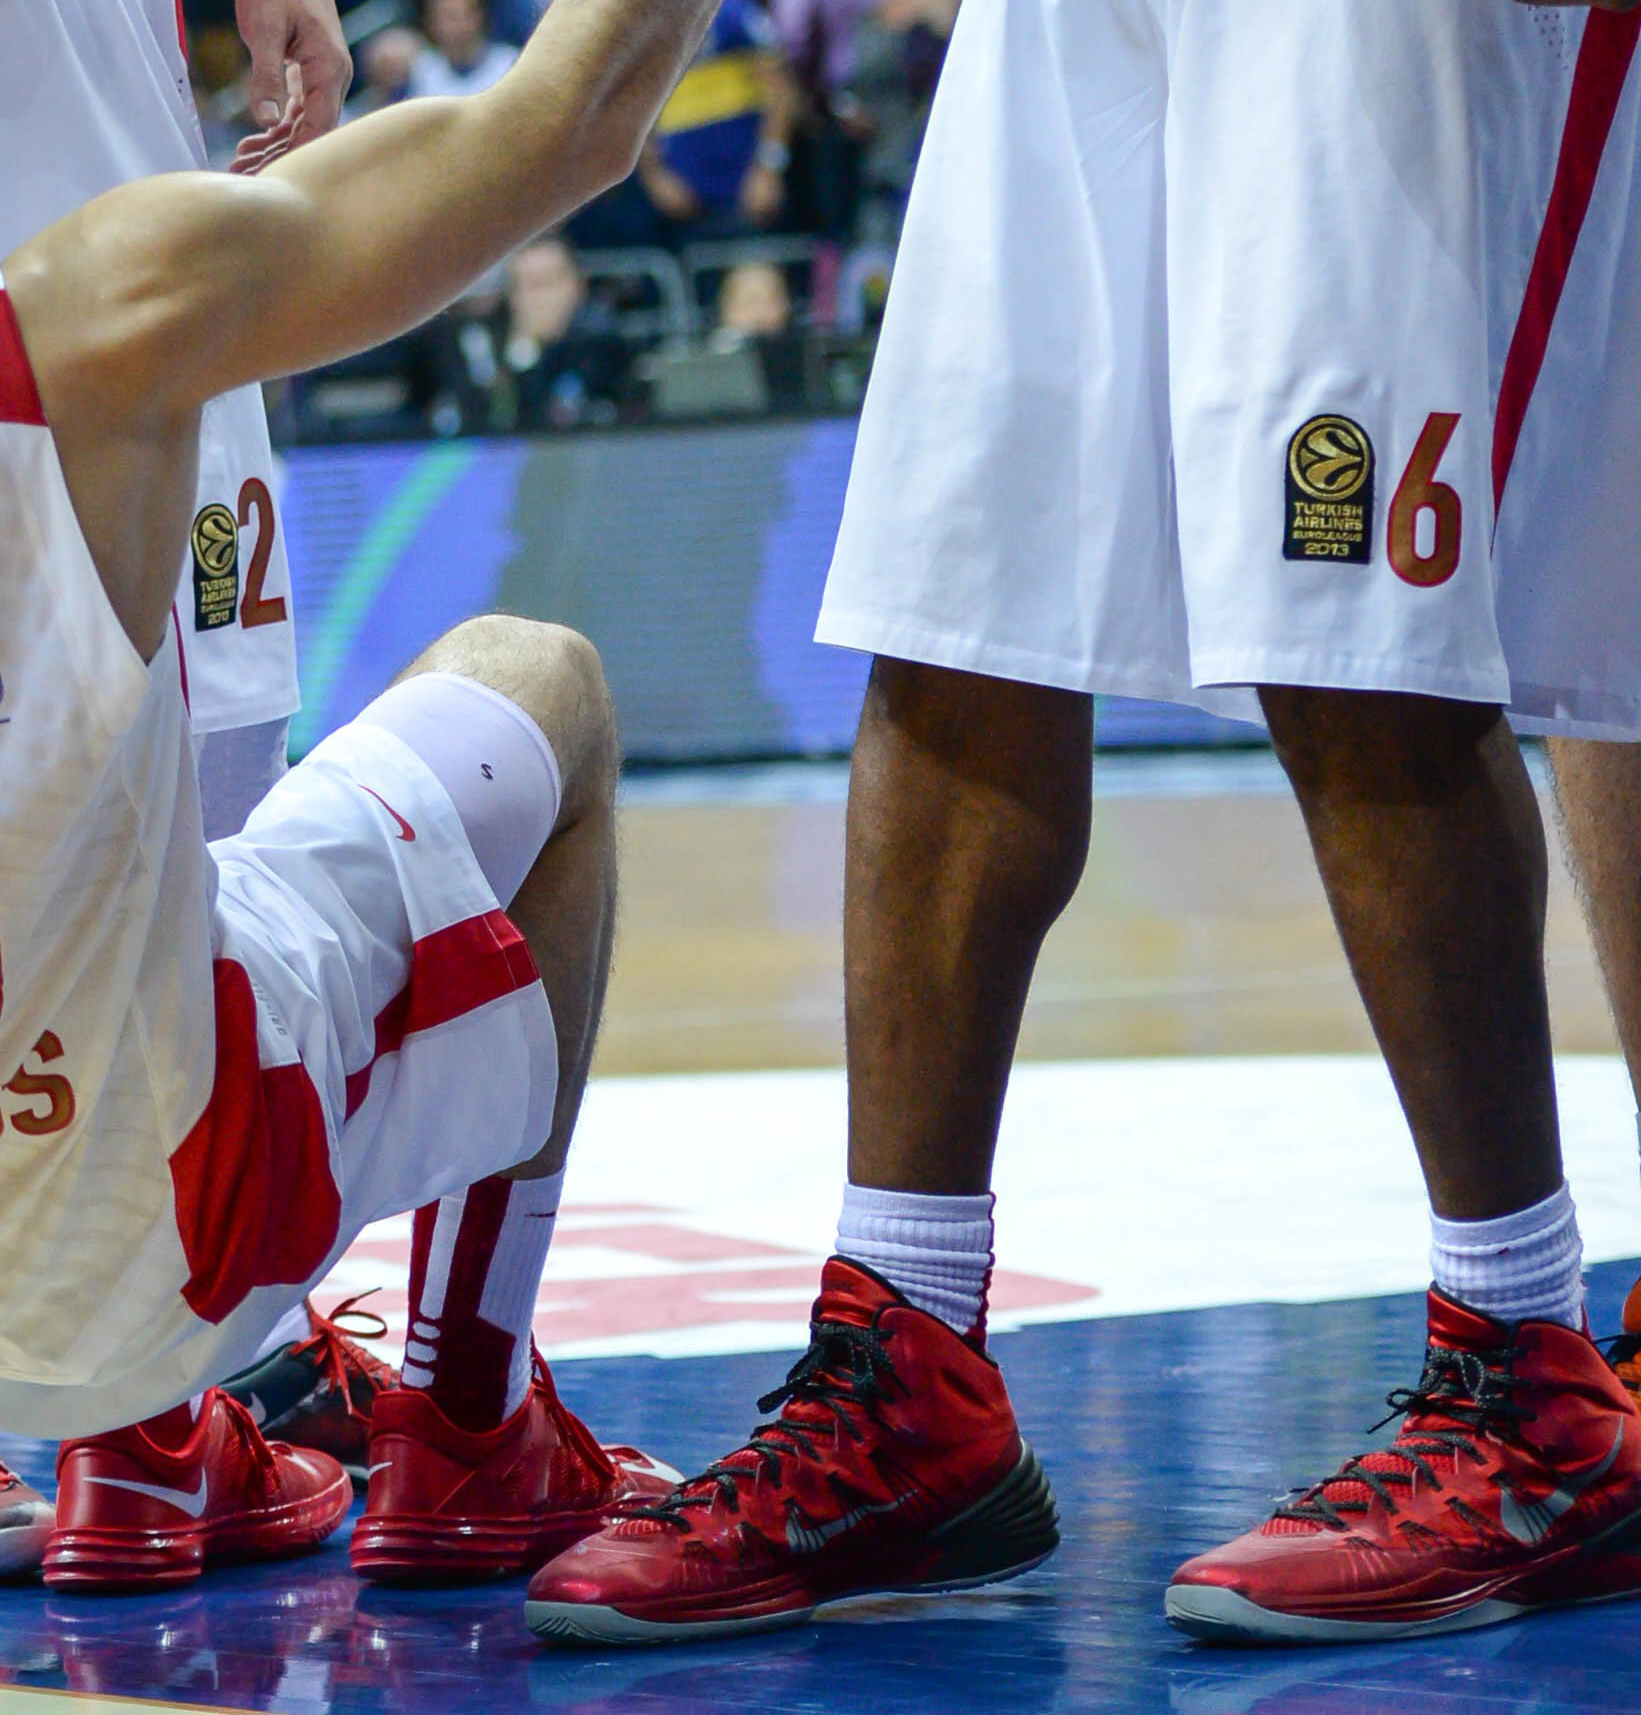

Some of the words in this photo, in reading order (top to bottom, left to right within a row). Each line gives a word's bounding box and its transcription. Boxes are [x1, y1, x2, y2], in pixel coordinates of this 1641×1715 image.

[1386, 411, 1463, 589] 6
[1293, 501, 1363, 517] TURKISH
[1292, 516, 1363, 531] AIRLINES
[1304, 542, 1349, 557] 2013
